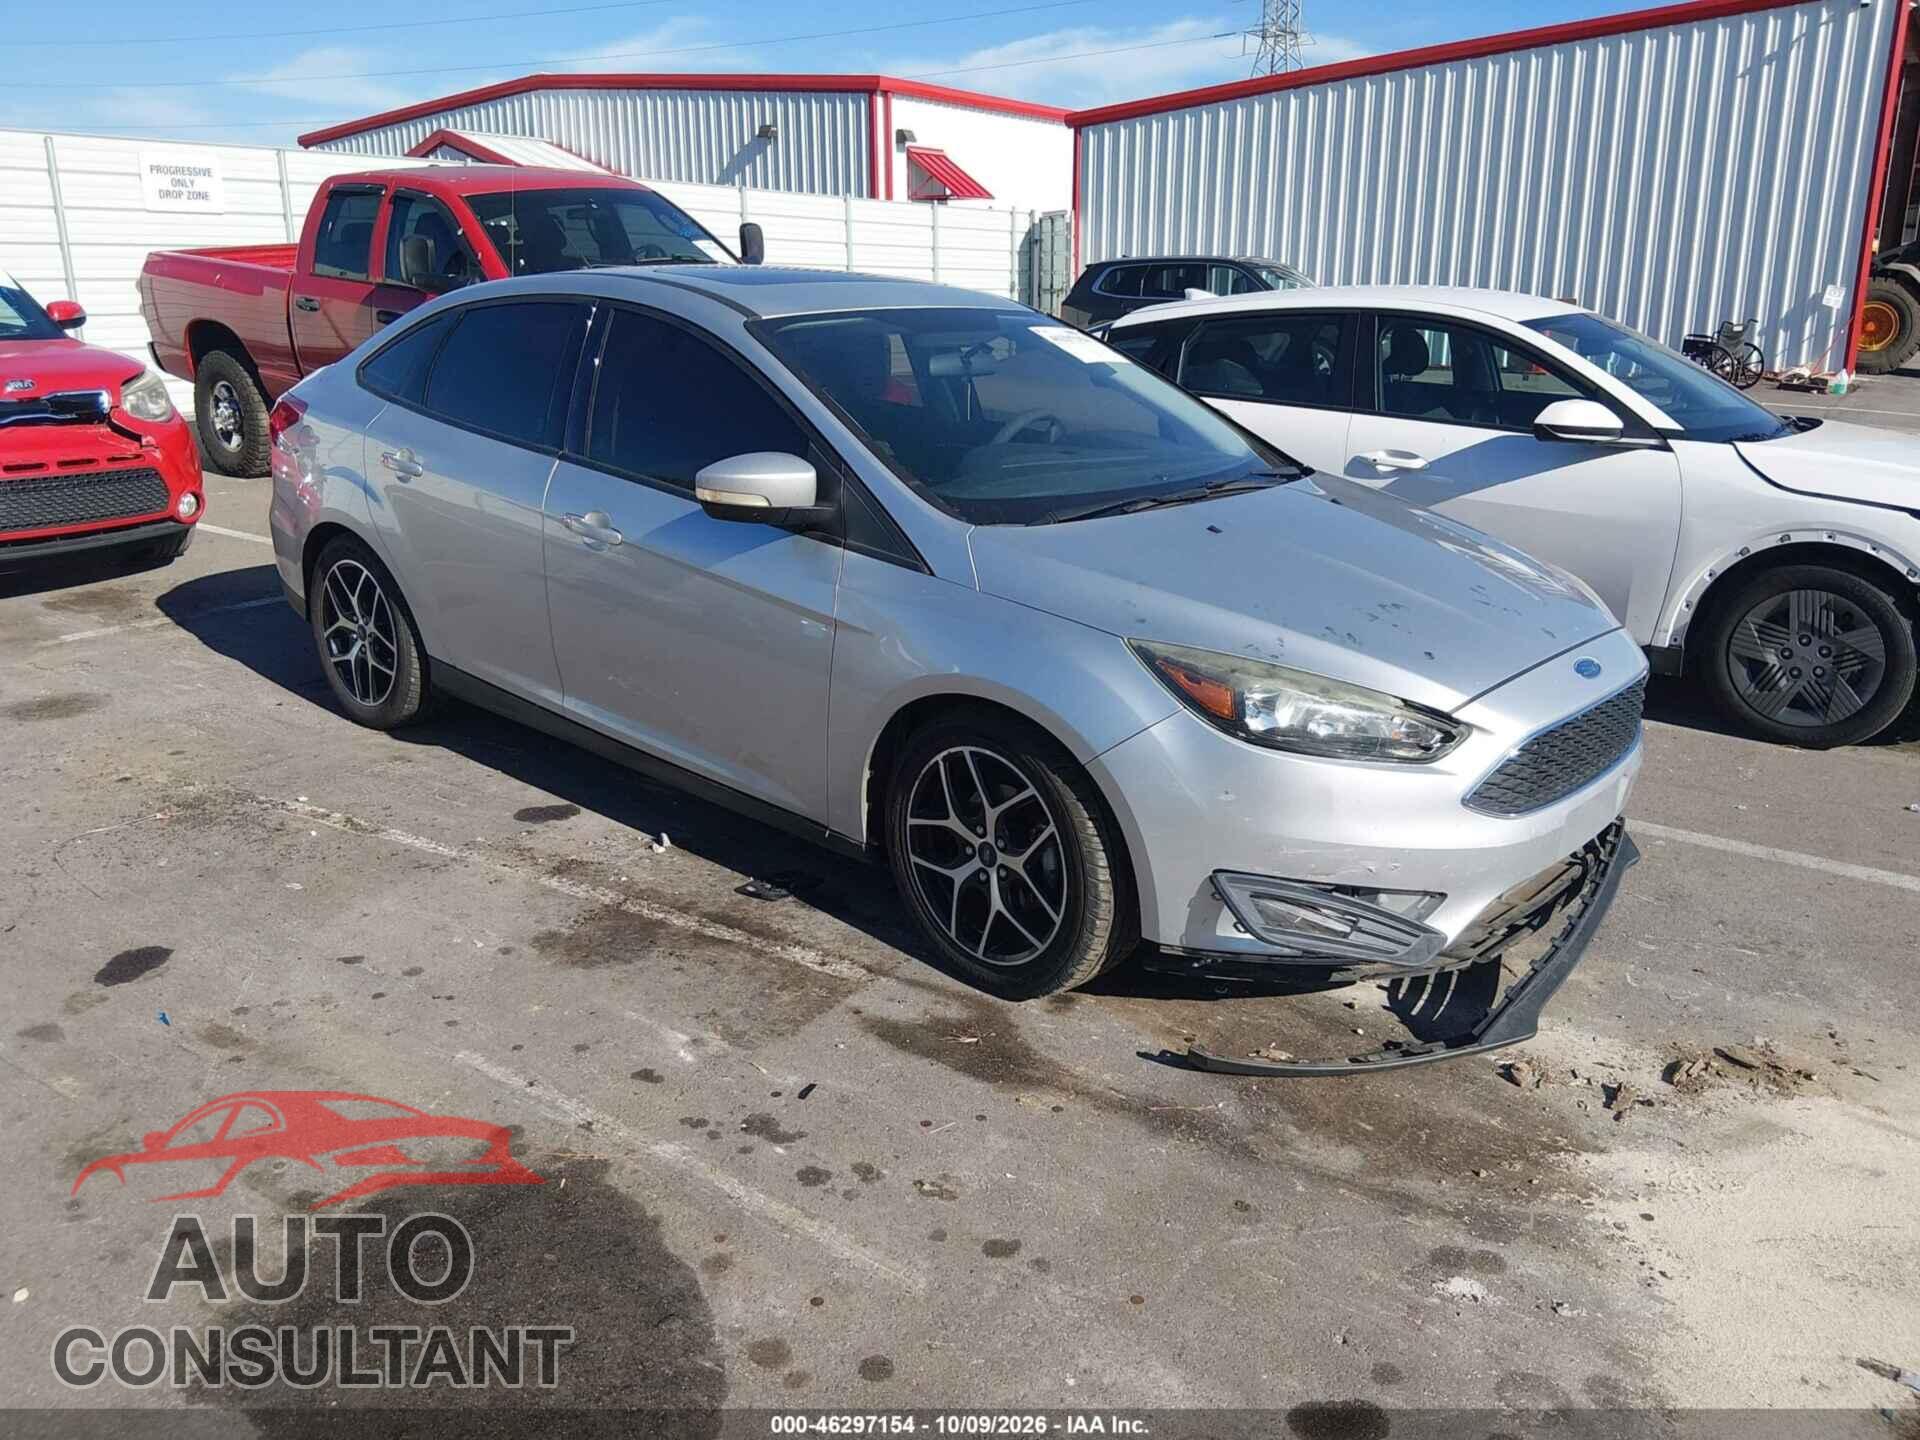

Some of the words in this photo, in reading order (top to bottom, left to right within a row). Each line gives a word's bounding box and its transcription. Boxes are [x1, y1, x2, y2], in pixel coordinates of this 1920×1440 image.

[150, 165, 212, 177] PROGRESSIVE
[171, 177, 194, 188] ONLY
[159, 189, 183, 200] DROP
[187, 191, 209, 201] ZONE
